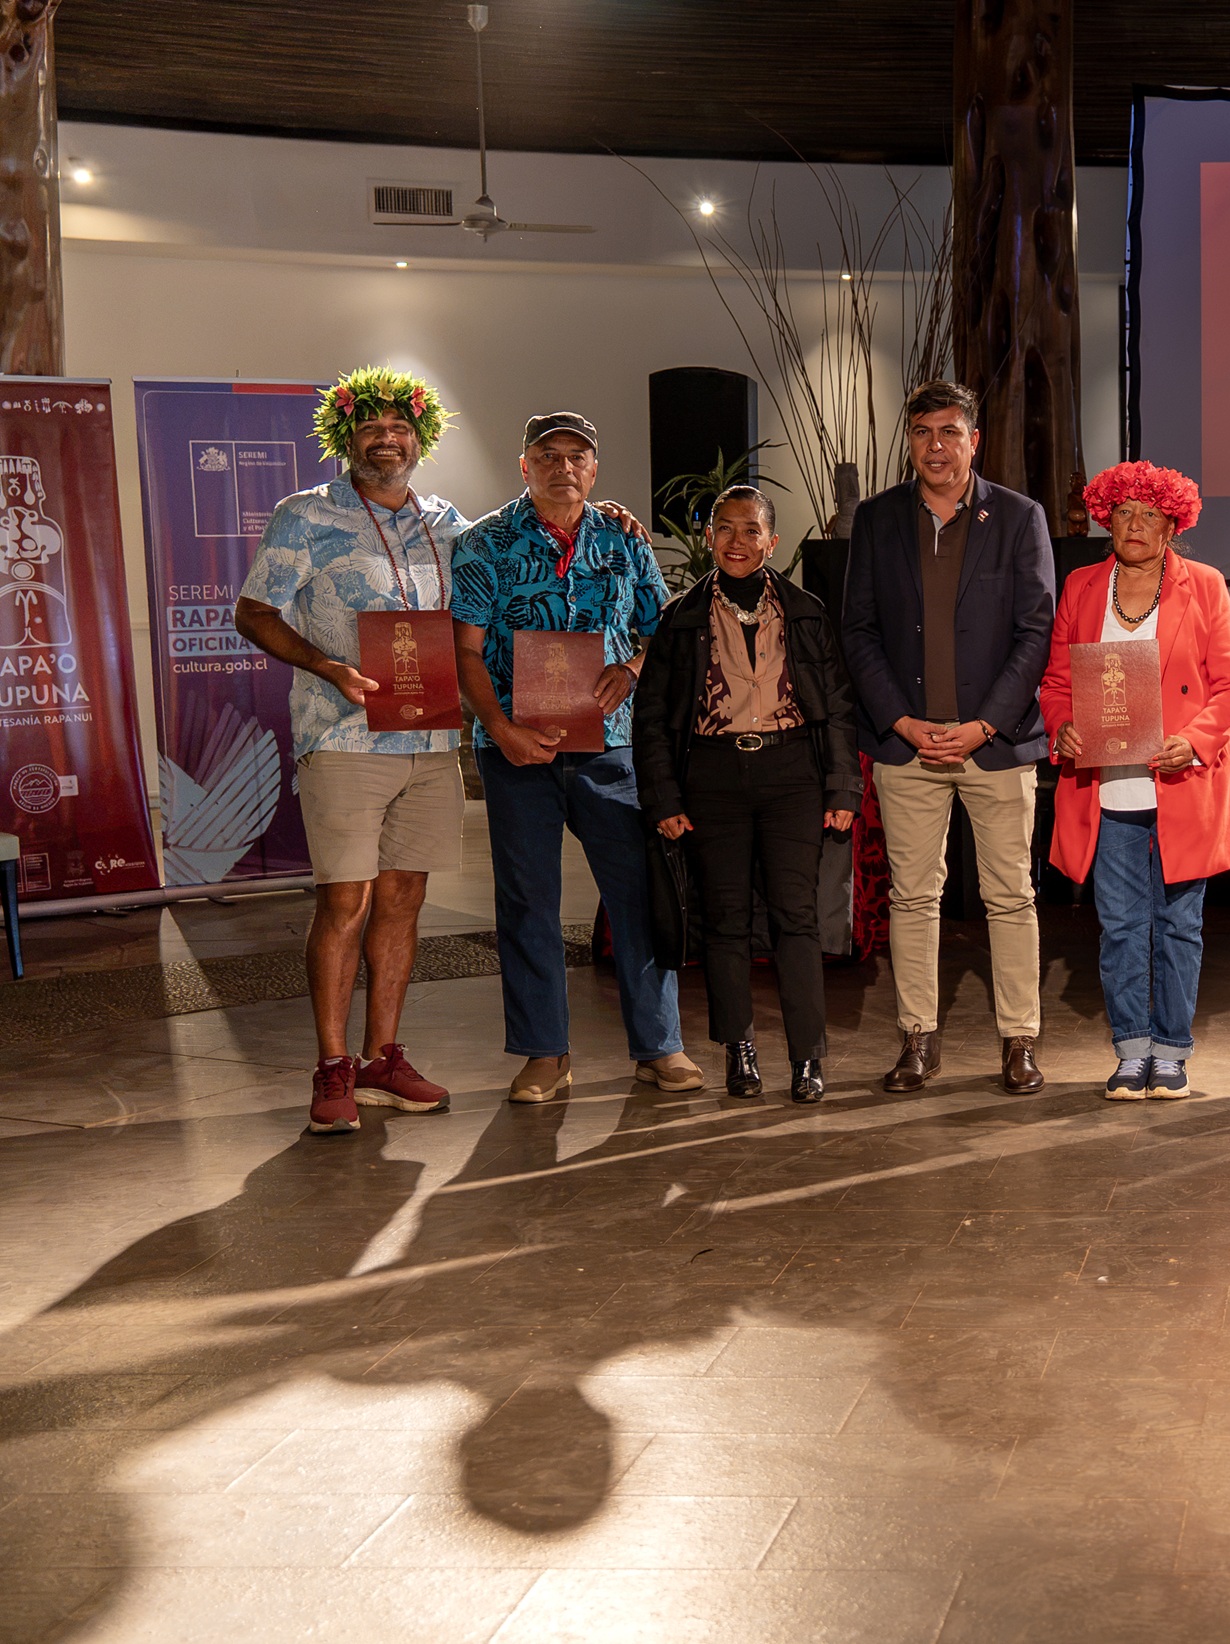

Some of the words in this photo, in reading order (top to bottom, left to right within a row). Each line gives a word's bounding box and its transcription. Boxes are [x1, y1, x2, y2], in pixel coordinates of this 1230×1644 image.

[168, 585, 234, 600] SEREMI
[172, 608, 235, 628] RAPA
[172, 636, 251, 652] OFICINA
[0, 653, 77, 677] APA'O
[173, 658, 268, 674] cultura.gob.cl
[0, 682, 90, 707] UPUNA
[44, 714, 73, 724] RAPA
[74, 712, 93, 723] NUI
[1103, 706, 1127, 714] TAPA'O
